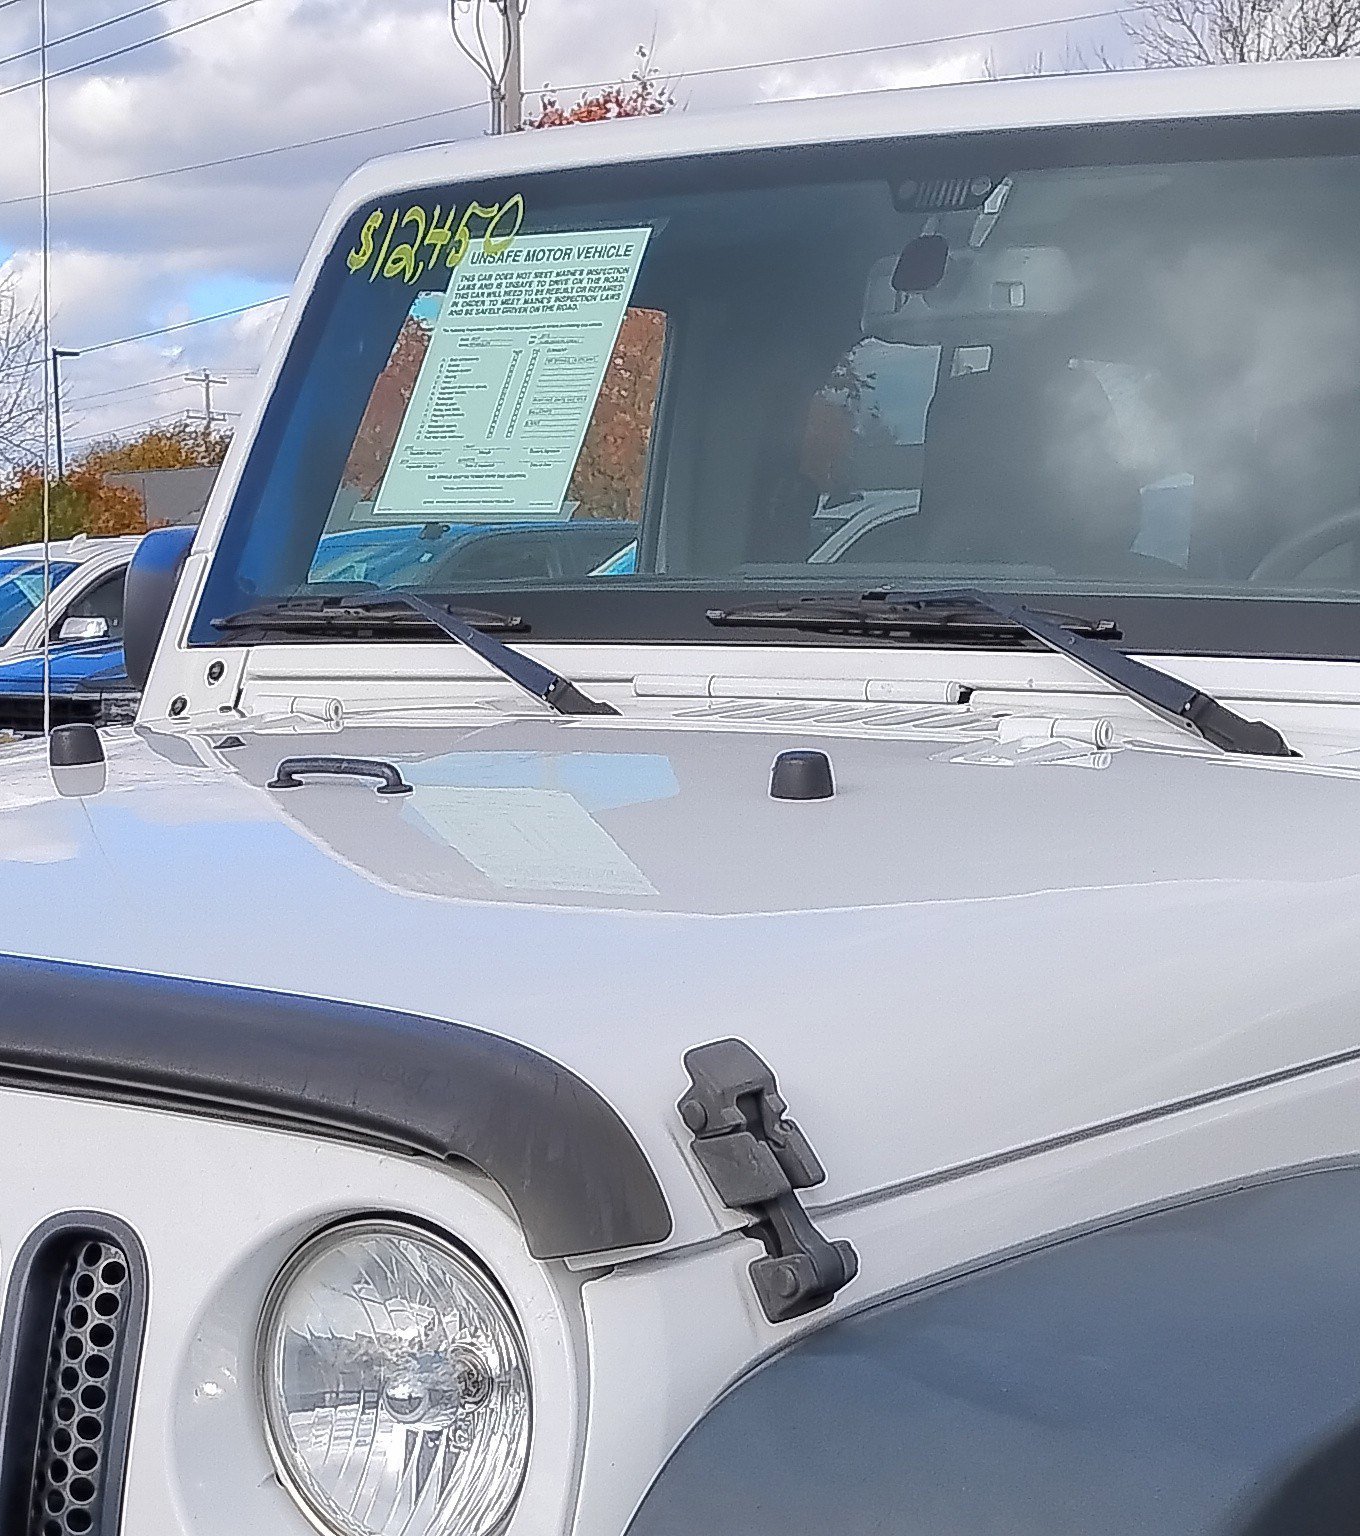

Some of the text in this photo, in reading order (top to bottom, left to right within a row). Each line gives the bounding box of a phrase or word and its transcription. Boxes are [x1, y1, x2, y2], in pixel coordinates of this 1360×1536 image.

[470, 244, 635, 265] UNSAFE MOTOR VEHICLE
